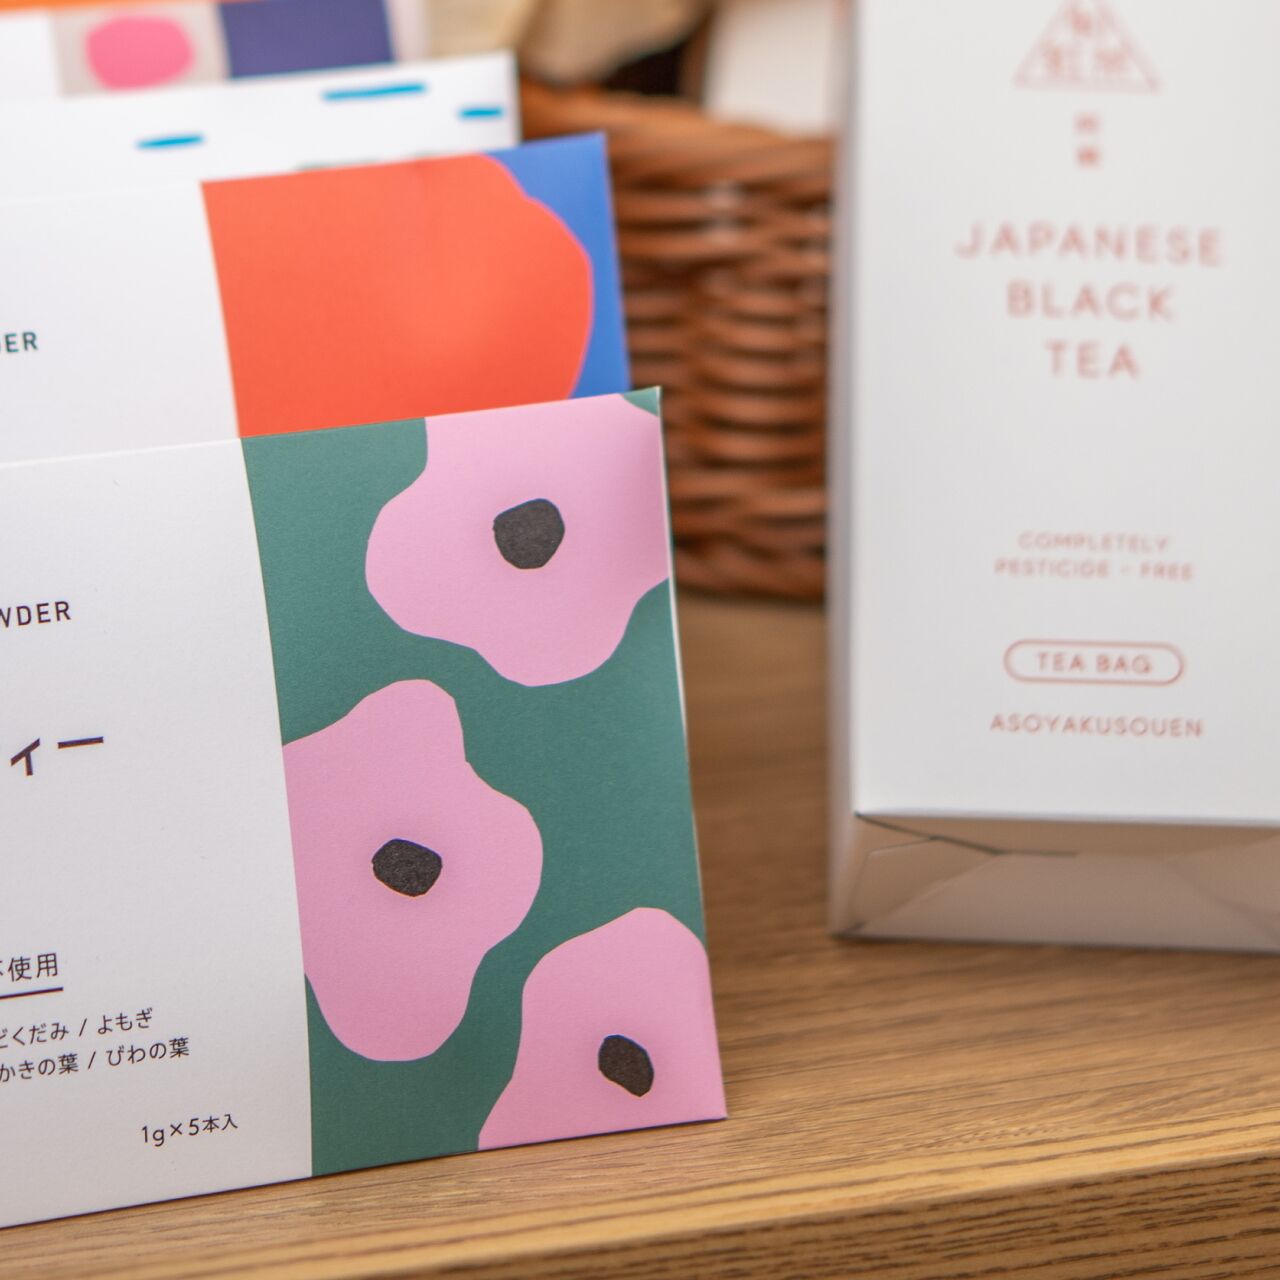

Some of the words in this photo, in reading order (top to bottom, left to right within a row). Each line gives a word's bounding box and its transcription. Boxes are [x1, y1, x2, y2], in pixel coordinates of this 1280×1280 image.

[955, 222, 1224, 267] JAPANESE
[1006, 279, 1176, 323] BLACK
[1045, 339, 1141, 380] TEA
[1018, 529, 1170, 554] COMPLETELY
[993, 558, 1110, 579] PESTICIDE
[1139, 560, 1194, 582] FREE
[1036, 651, 1087, 673] TEA
[1096, 653, 1154, 676] BAG
[990, 713, 1204, 739] ASOYAKUSOUEN
